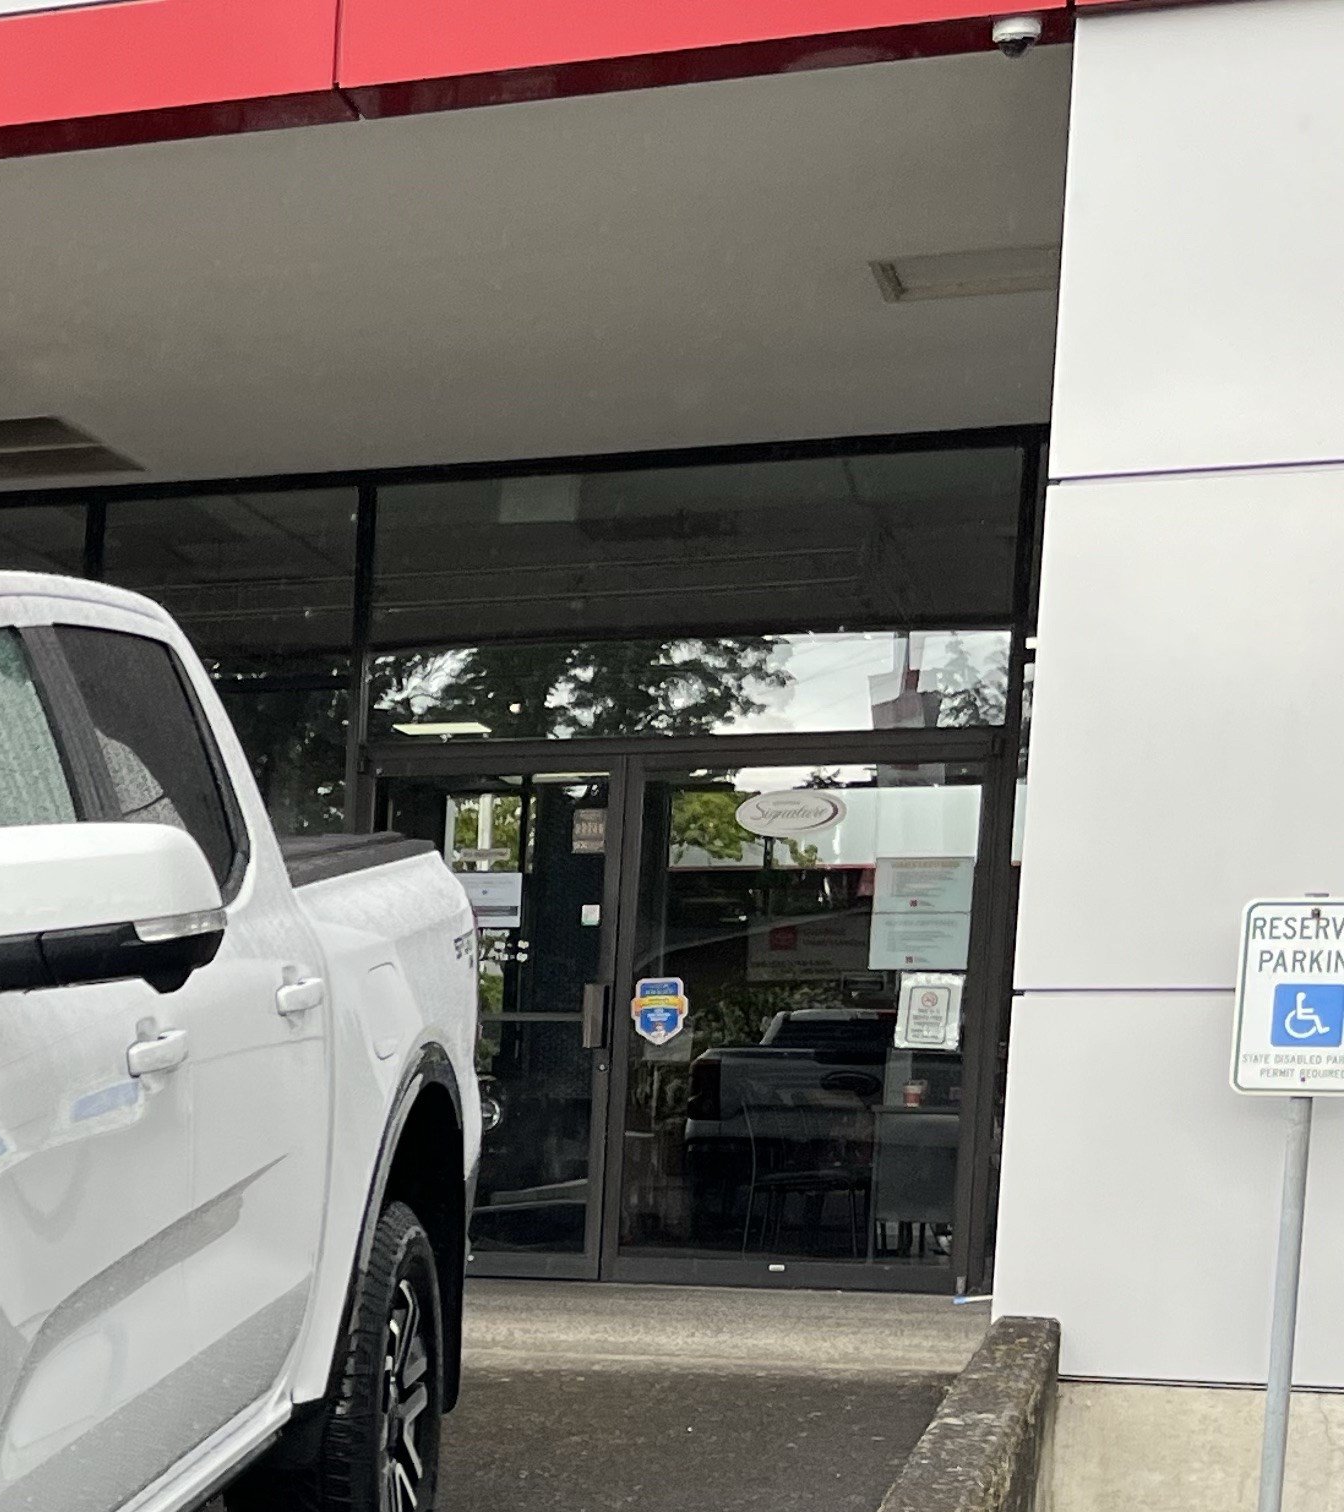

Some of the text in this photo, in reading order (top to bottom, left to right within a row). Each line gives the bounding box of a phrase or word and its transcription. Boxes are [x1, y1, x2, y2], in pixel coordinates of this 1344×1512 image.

[1252, 916, 1344, 939] RESERV
[1258, 950, 1344, 973] PARKIN
[1274, 1054, 1322, 1064] DISABLED
[1259, 1068, 1295, 1078] PERMIT
